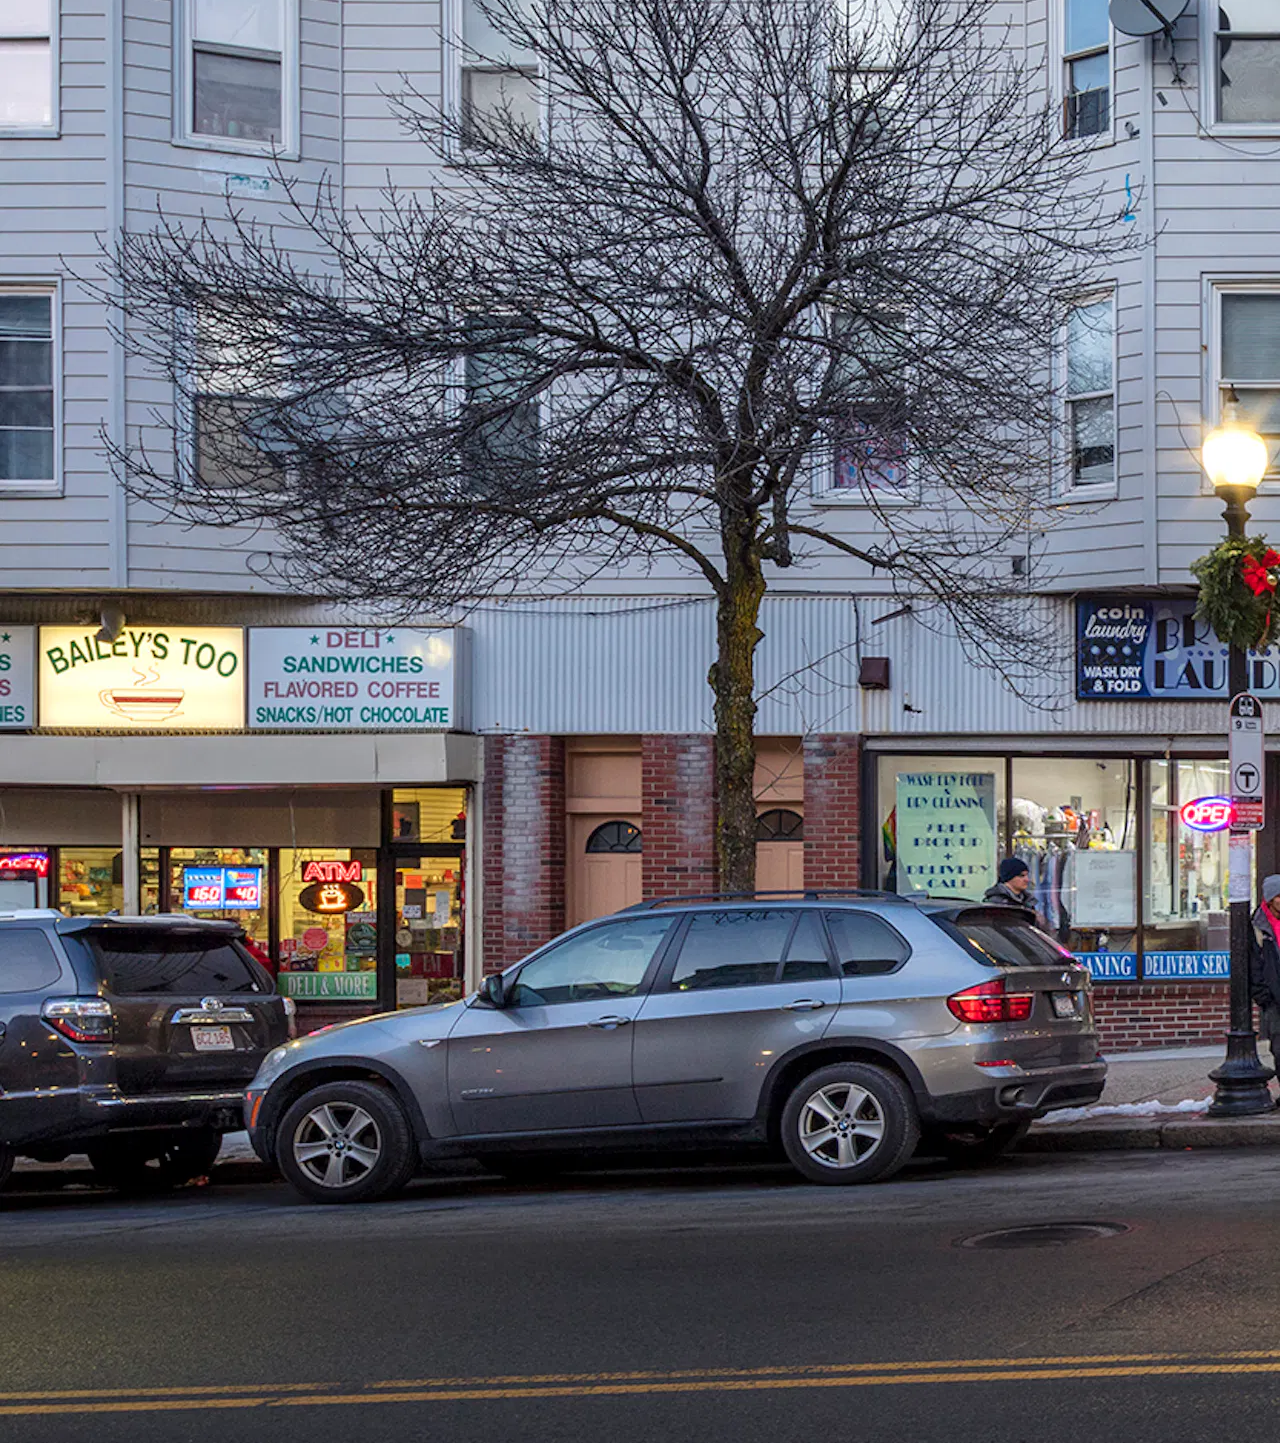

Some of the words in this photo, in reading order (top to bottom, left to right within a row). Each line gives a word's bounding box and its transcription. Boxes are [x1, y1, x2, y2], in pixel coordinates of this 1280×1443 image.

[1097, 605, 1144, 620] coin
[1084, 614, 1147, 644] laundry
[326, 632, 380, 648] DELI
[46, 630, 169, 675] BAILEY'S
[180, 637, 238, 677] TOO
[282, 655, 424, 674] SANDWICHES
[1121, 666, 1142, 678] DRY
[263, 681, 358, 698] FLAVORED
[367, 681, 440, 698] COFFEE
[1093, 680, 1105, 692] &
[1107, 680, 1142, 692] FOLD
[256, 706, 354, 724] SNACKS/HOT
[360, 707, 449, 723] CHOCOLATE
[1235, 720, 1242, 729] 9
[303, 861, 361, 881] ATM
[193, 886, 220, 900] 160
[236, 887, 257, 900] 40
[1144, 955, 1199, 975] DELIVERY
[288, 976, 317, 995] DELI
[321, 976, 329, 995] &
[334, 976, 369, 995] MORE
